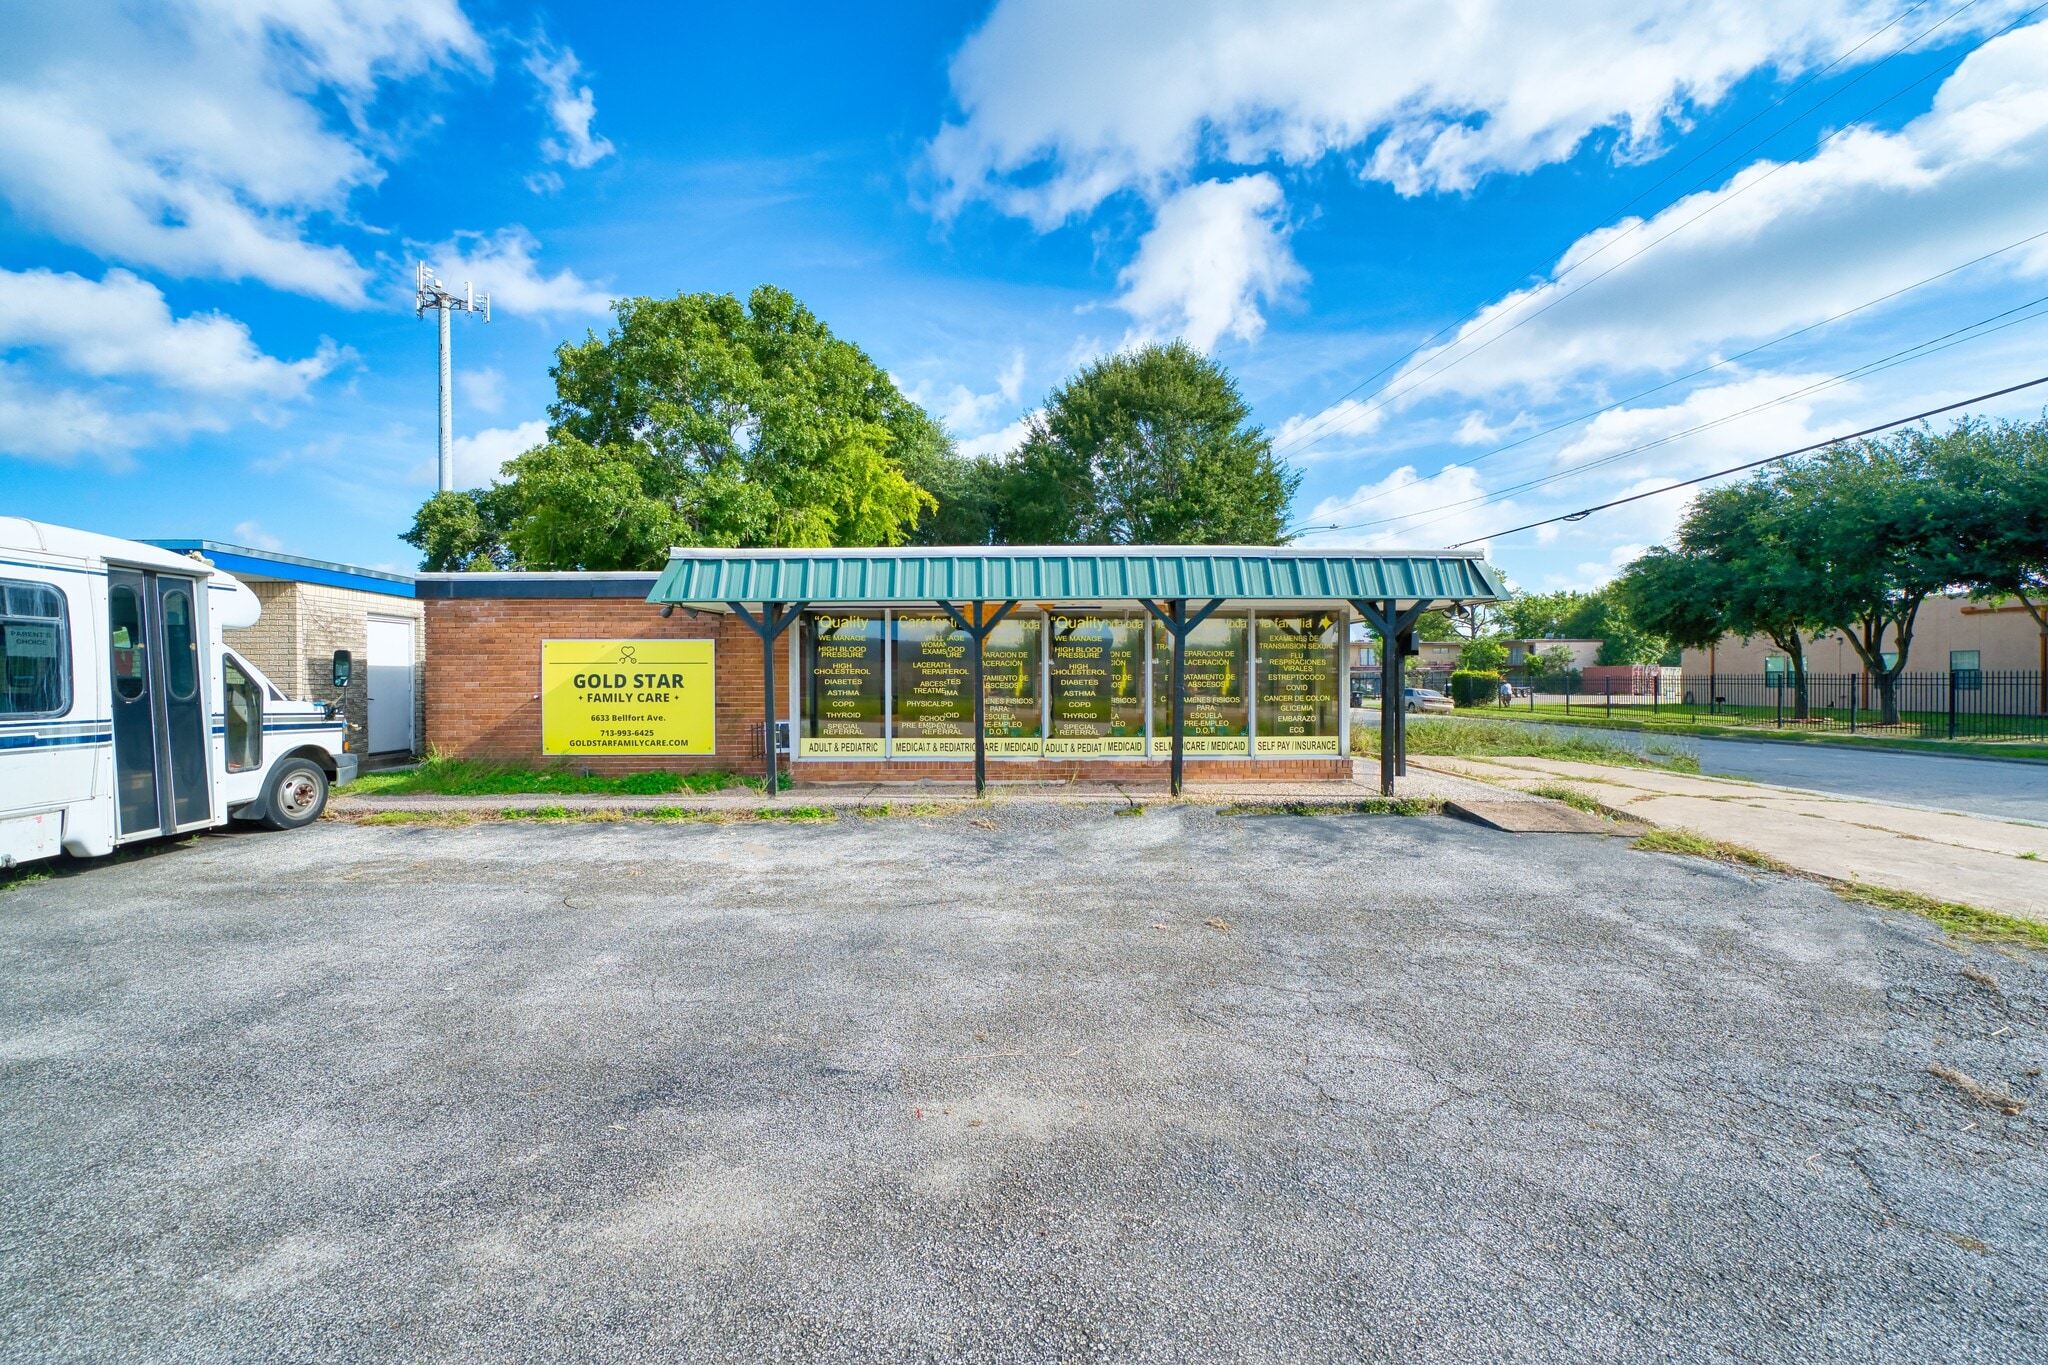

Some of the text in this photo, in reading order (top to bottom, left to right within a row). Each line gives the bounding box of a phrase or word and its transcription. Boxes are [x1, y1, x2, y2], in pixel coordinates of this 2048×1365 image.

[818, 634, 866, 642] WE MANAGE
[574, 674, 684, 689] GOLD STAR
[587, 693, 670, 703] FAMILY CARE
[591, 714, 666, 722] 6633 Bellfort Ave.
[809, 742, 878, 752] ADULT & PEDIATRIC
[1004, 743, 1039, 752] MEDICAID
[1045, 744, 1068, 752] ADULT
[1070, 744, 1076, 752] &
[1108, 742, 1142, 752] MEDICAID
[1211, 742, 1246, 751] MEDICAID
[1258, 742, 1276, 751] SELF
[1277, 742, 1290, 751] PAY
[1295, 741, 1336, 750] INSURANCE
